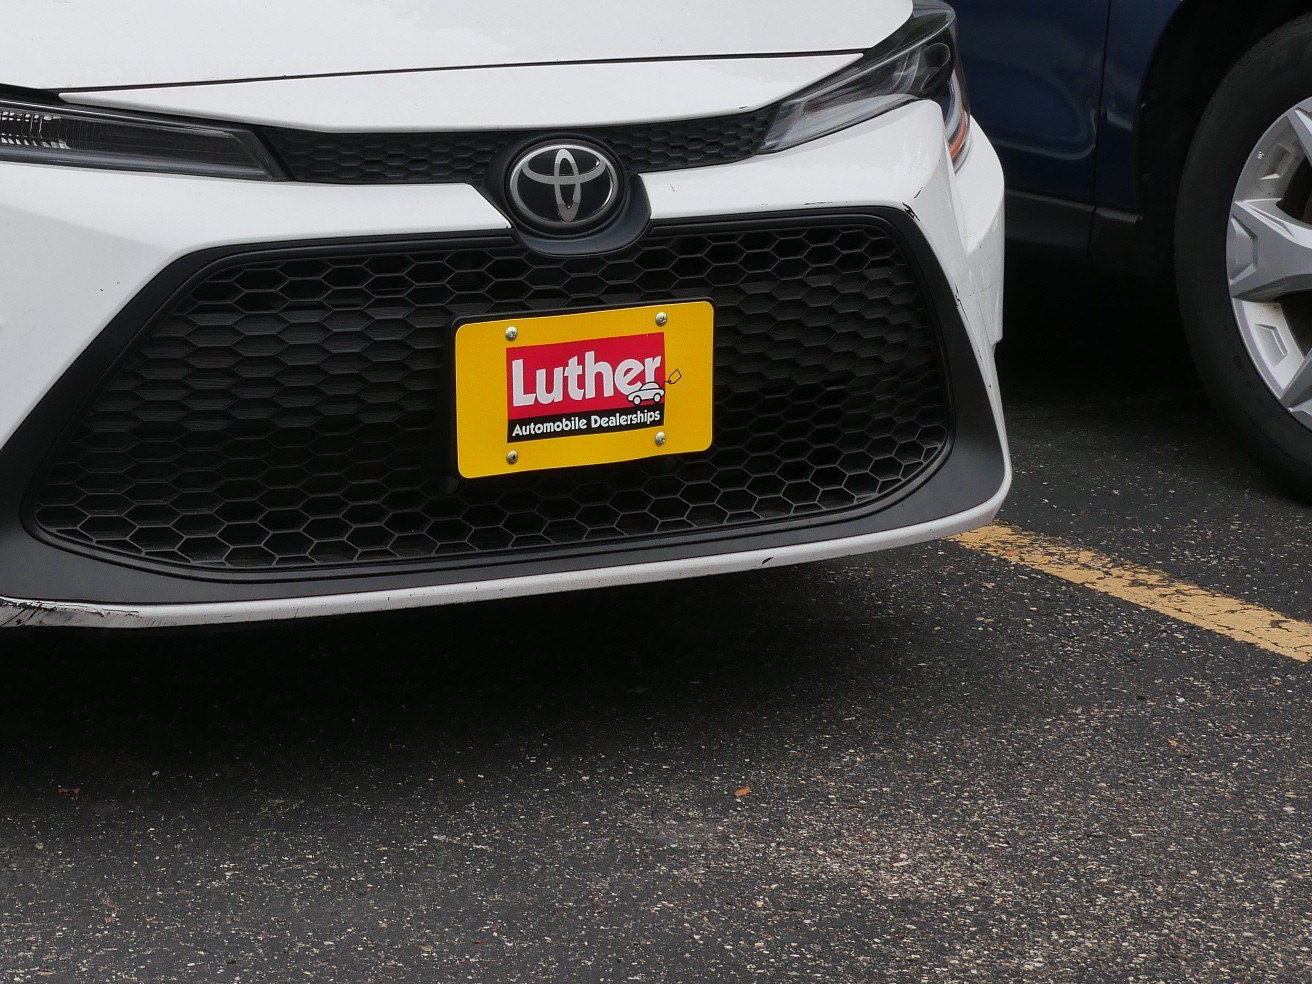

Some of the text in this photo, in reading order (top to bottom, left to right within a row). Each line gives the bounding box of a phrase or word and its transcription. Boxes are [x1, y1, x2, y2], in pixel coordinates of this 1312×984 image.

[512, 351, 662, 407] Luther
[512, 410, 661, 437] Automobile Dealerships
